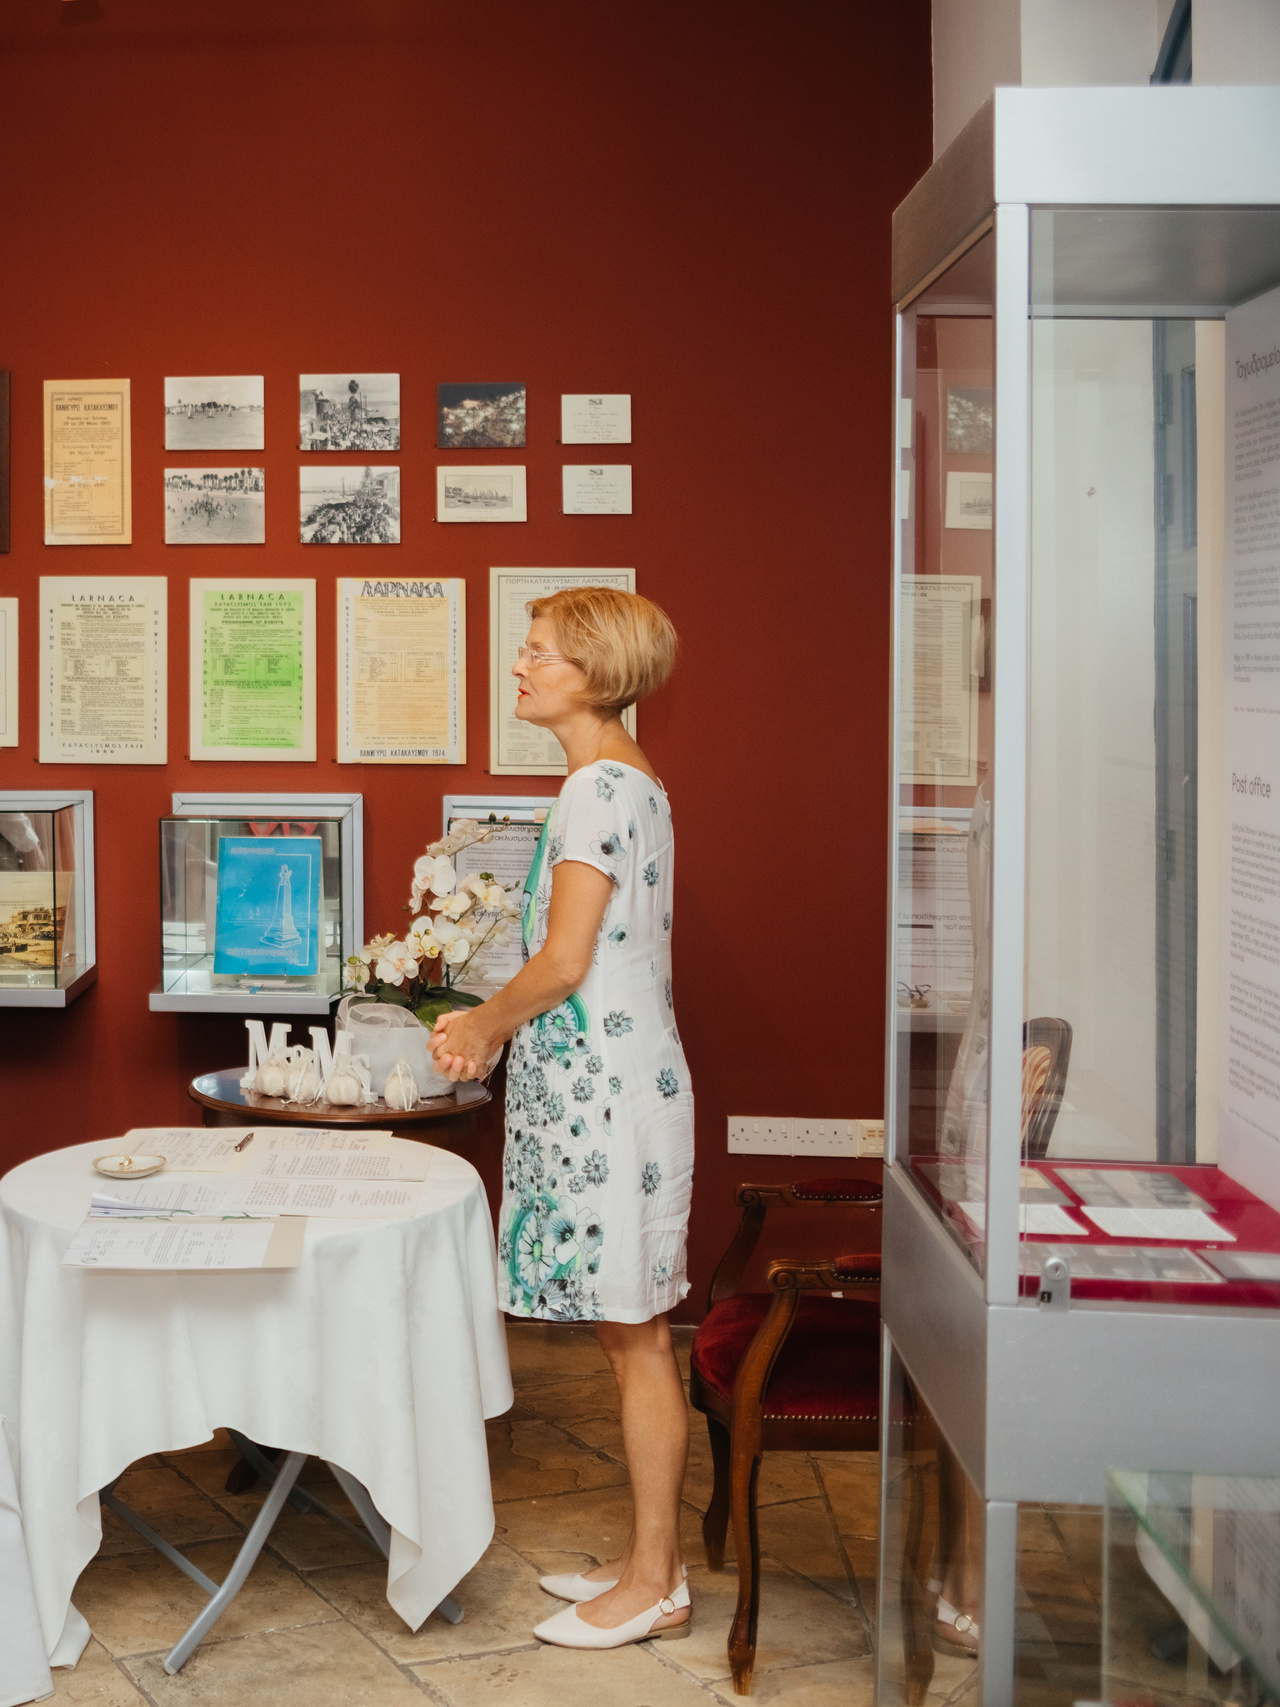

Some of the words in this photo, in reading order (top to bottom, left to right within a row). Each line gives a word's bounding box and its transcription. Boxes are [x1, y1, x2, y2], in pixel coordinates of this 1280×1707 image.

[361, 581, 444, 598] ΛΑΡΝΑΚΑ
[1232, 772, 1247, 794] Post
[1249, 776, 1271, 798] office
